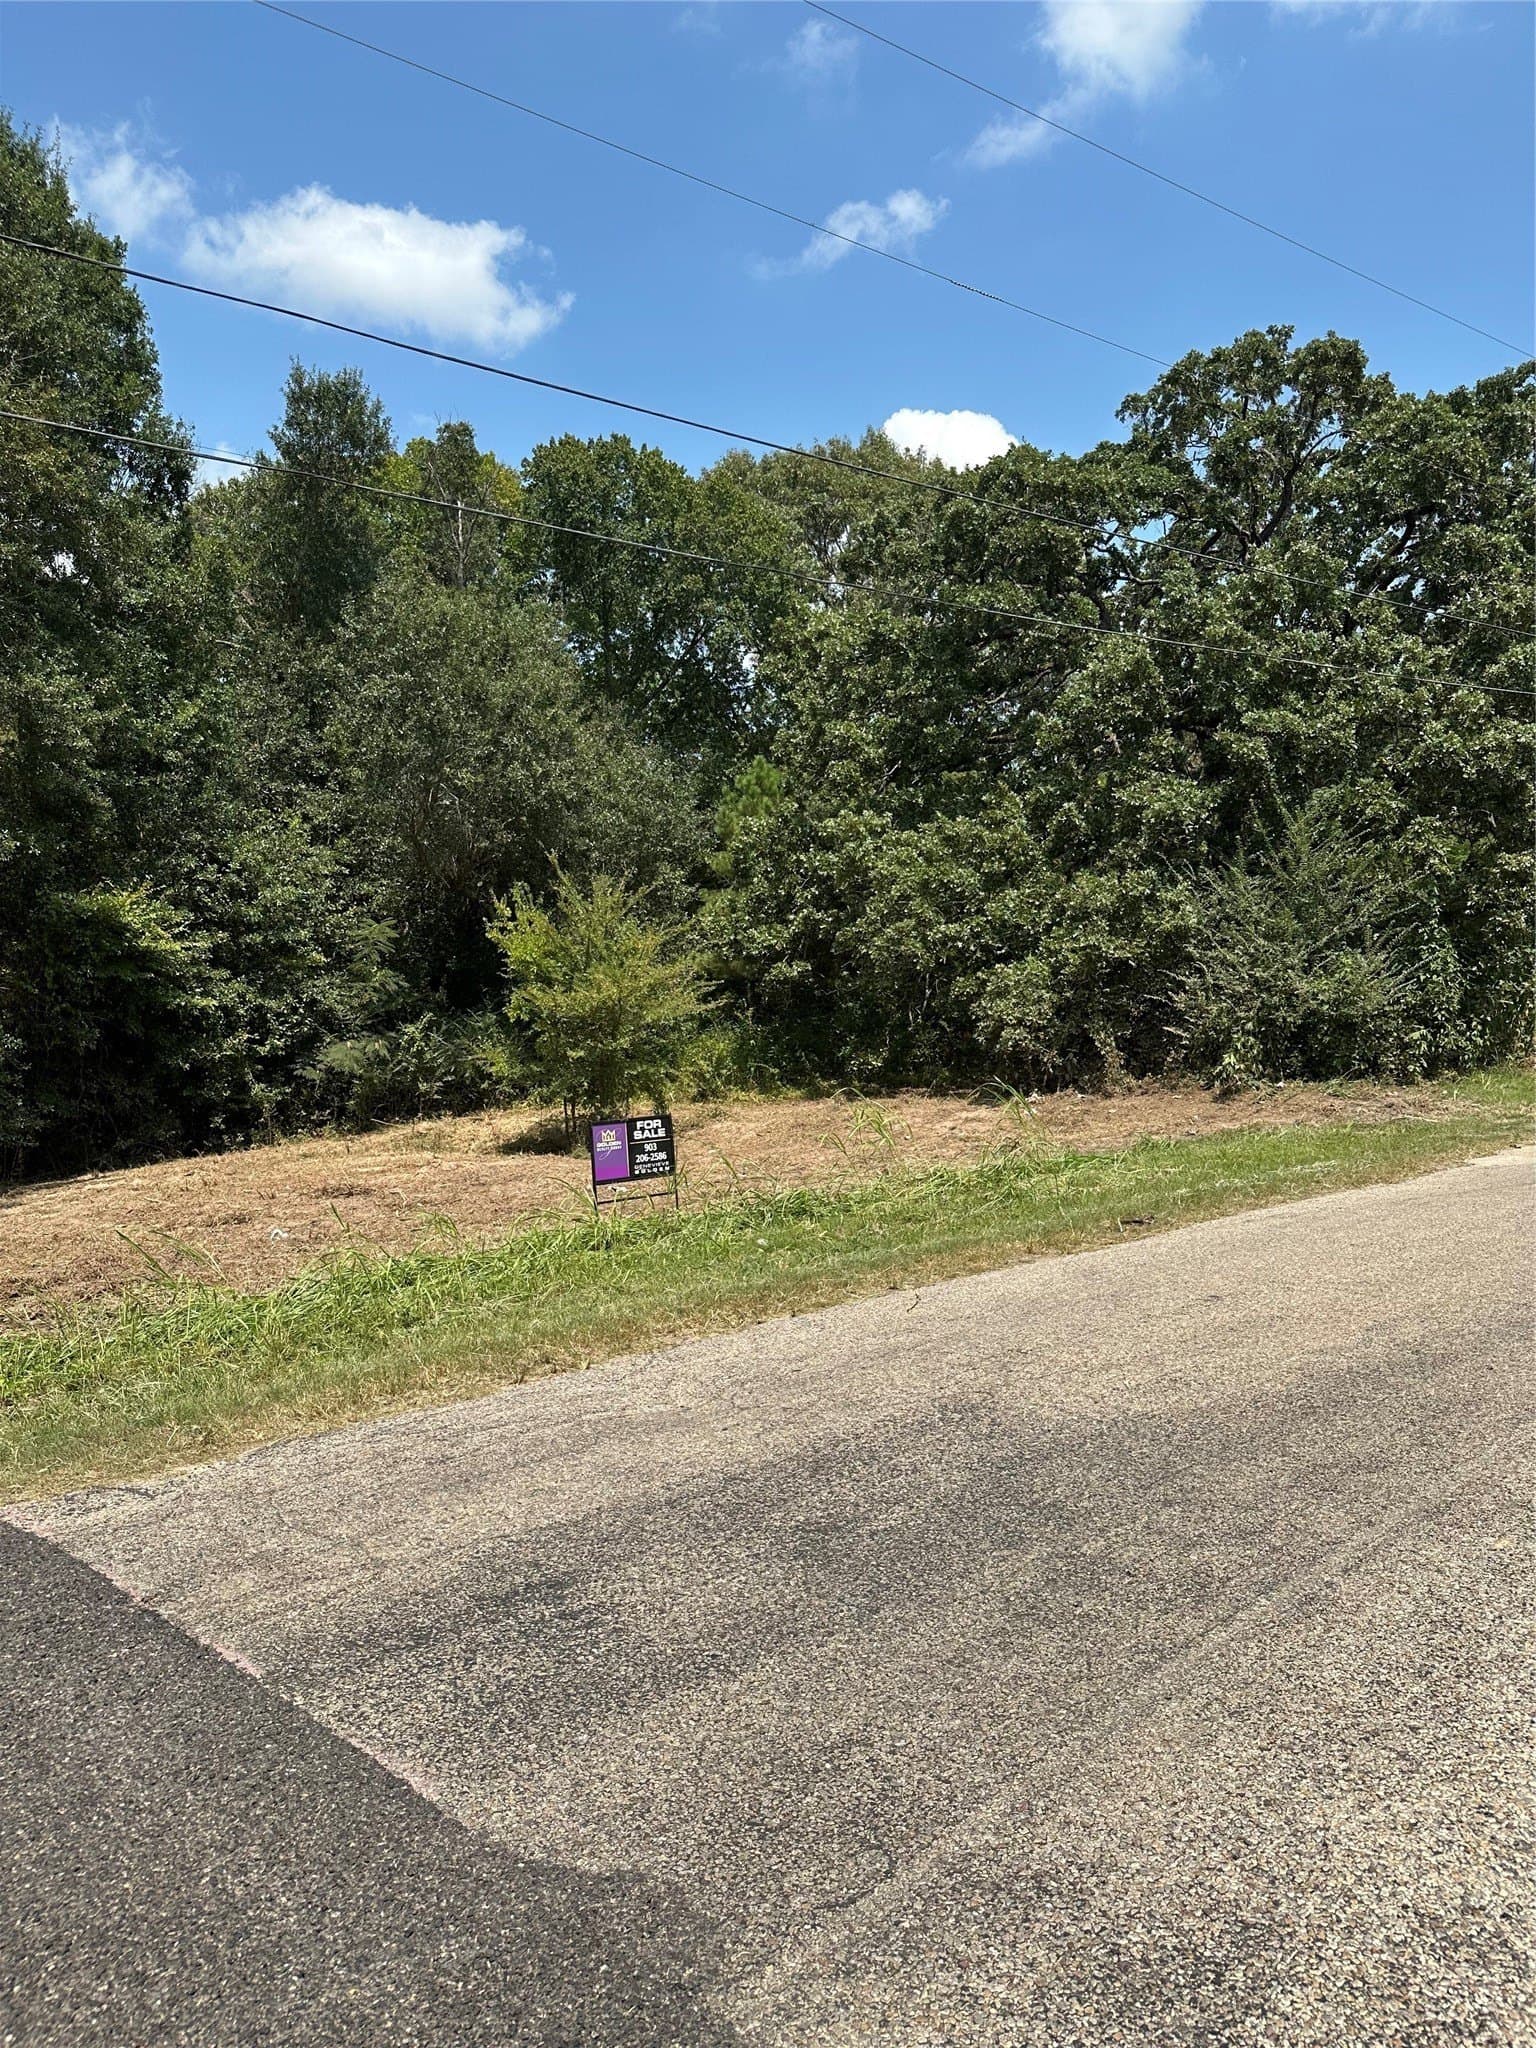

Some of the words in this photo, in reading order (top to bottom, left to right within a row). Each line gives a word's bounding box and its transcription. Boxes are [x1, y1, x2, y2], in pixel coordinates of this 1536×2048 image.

[636, 1119, 662, 1130] FOR
[634, 1128, 666, 1139] SALE
[644, 1143, 657, 1152] 903
[635, 1152, 667, 1163] 206-2586
